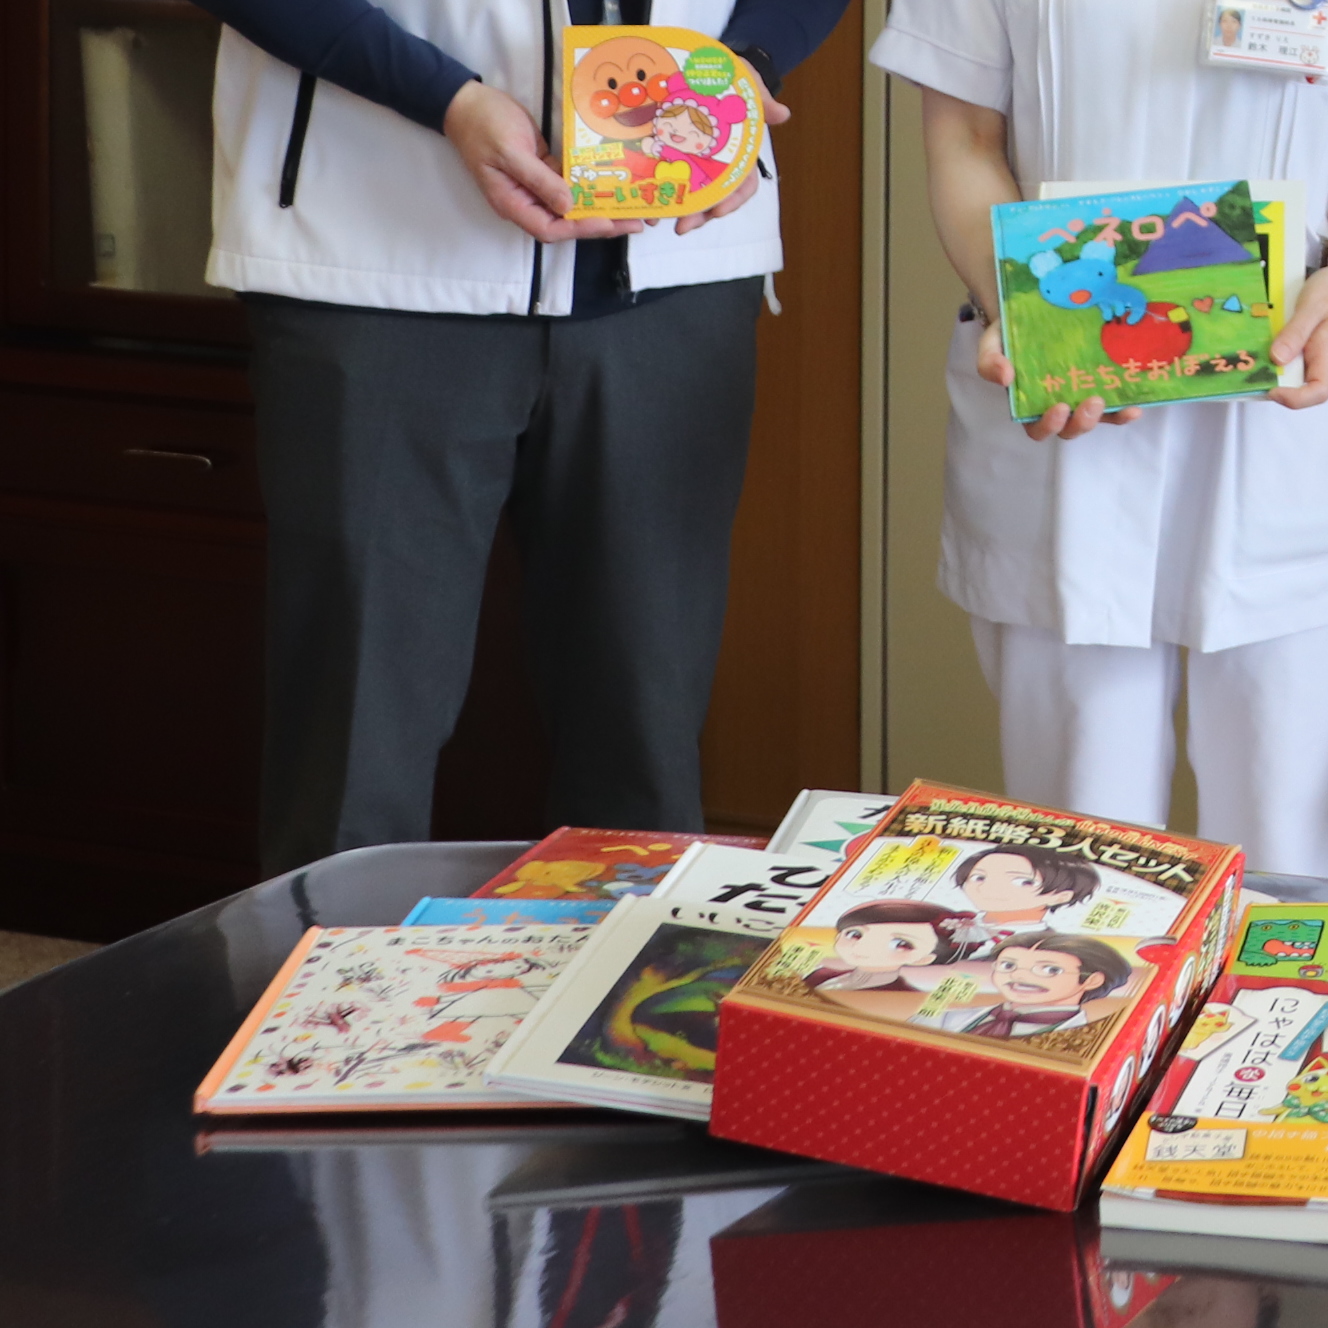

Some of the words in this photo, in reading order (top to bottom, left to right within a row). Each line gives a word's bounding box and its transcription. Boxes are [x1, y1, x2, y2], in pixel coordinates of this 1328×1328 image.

[1038, 202, 1217, 248] ペネロペ
[1044, 350, 1256, 392] かたちをおぼえる
[904, 813, 1194, 883] 新紙幣3人セット
[1153, 1143, 1237, 1159] 銭天堂
